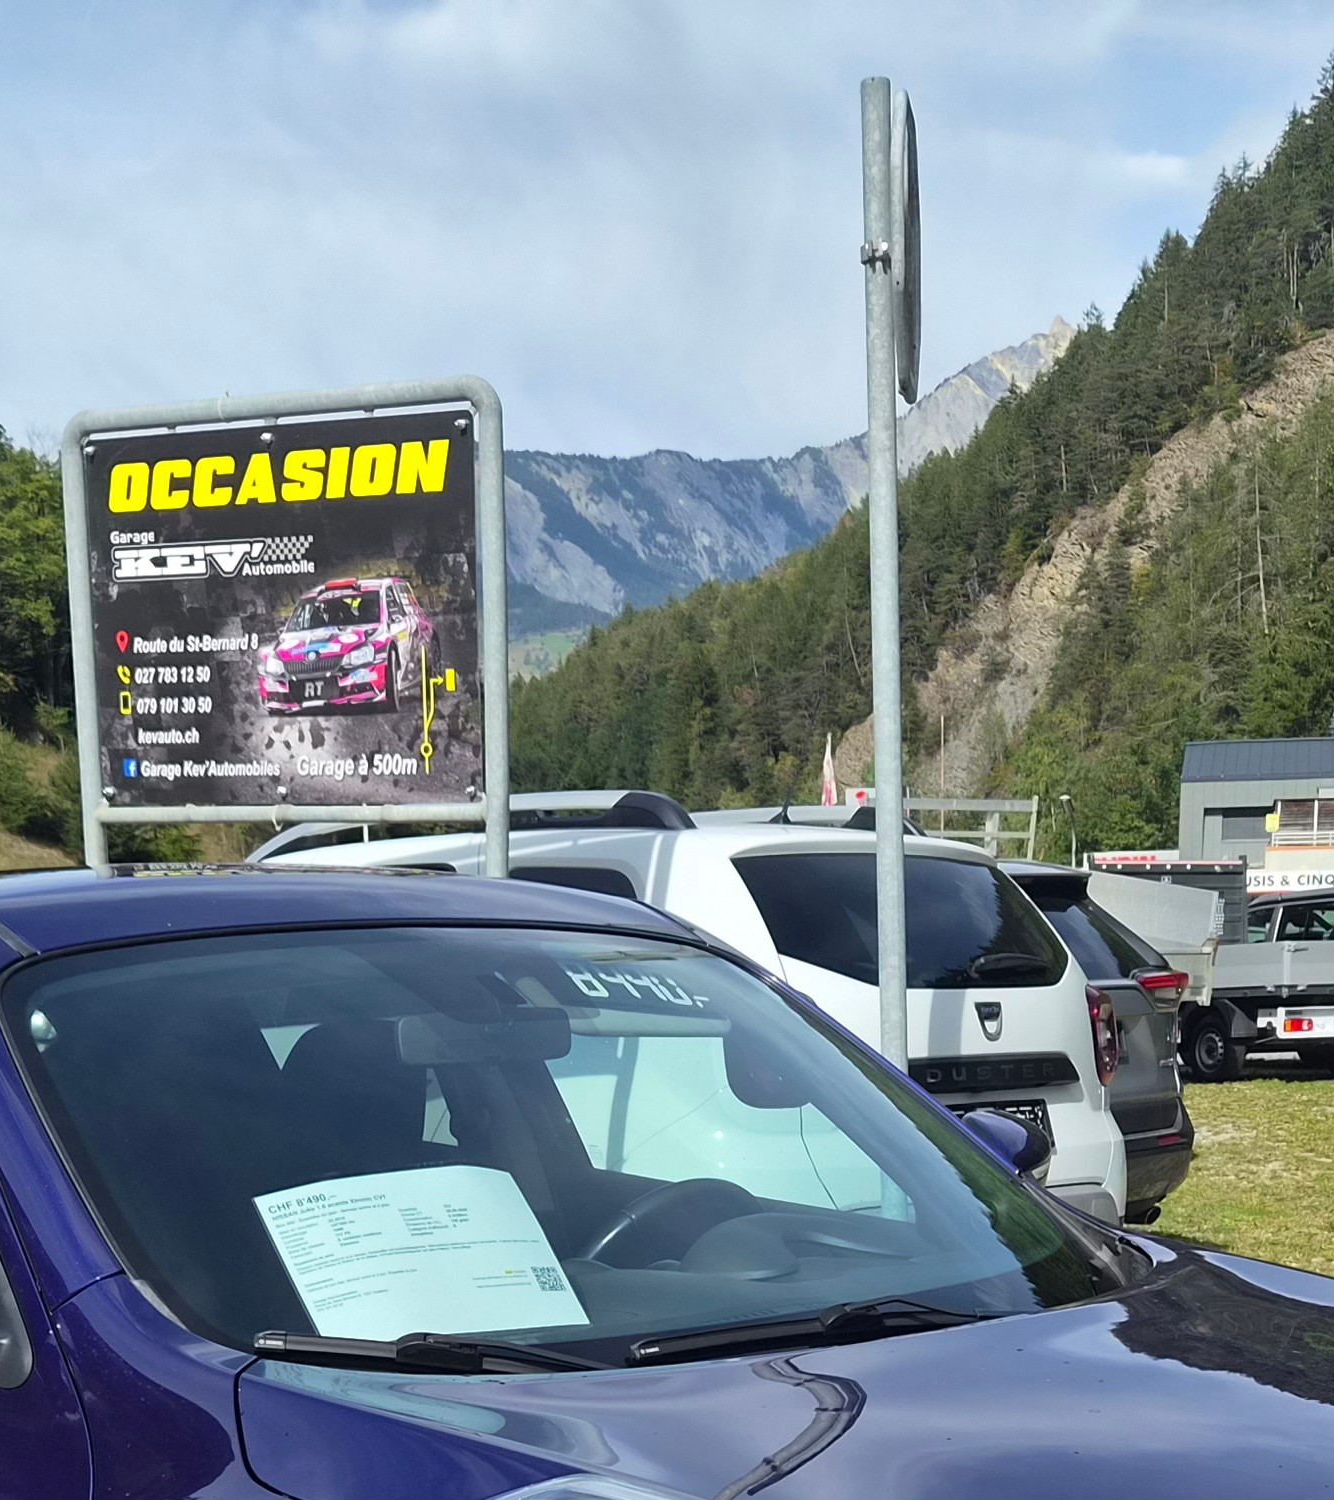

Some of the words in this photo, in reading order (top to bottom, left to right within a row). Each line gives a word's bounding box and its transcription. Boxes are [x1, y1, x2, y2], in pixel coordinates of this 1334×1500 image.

[108, 440, 450, 513] OCCASION
[110, 531, 155, 545] Garage
[243, 560, 315, 576] Automobile
[133, 636, 168, 653] Route
[169, 635, 184, 653] du
[186, 632, 249, 652] St-Bernard
[250, 633, 259, 650] 8
[134, 667, 156, 684] 027
[157, 666, 178, 683] 783
[180, 666, 194, 683] 12
[196, 665, 211, 683] 50
[304, 681, 324, 698] RT
[136, 697, 157, 714] 079
[159, 697, 179, 714] 101
[180, 696, 196, 713] 30
[197, 696, 213, 713] 50
[138, 727, 200, 744] kevauto.ch
[140, 761, 182, 781] Garage
[297, 755, 355, 781] Garage
[358, 753, 369, 776] à
[372, 753, 418, 775] 500m
[1280, 875, 1290, 886] &
[926, 1062, 1056, 1083] DUSTER
[268, 1201, 293, 1215] CHF
[272, 1211, 299, 1221] NISSAN
